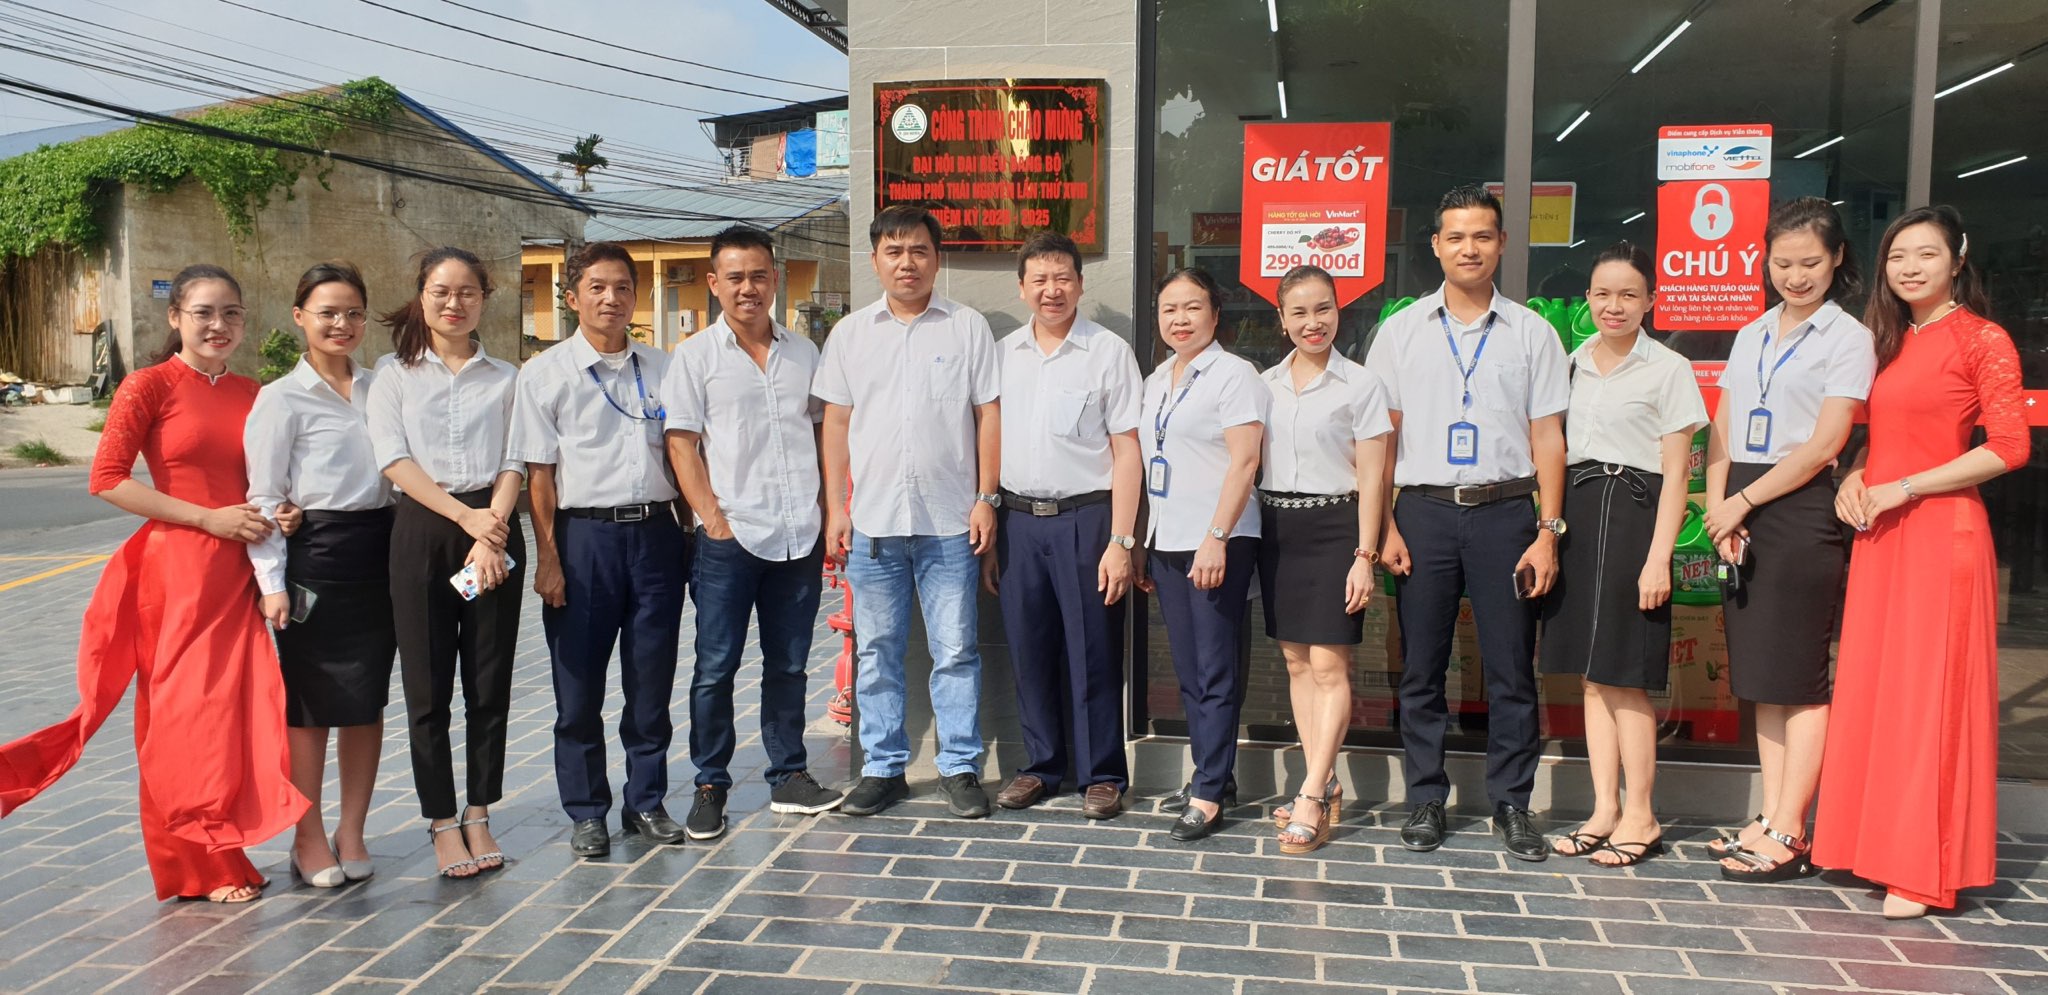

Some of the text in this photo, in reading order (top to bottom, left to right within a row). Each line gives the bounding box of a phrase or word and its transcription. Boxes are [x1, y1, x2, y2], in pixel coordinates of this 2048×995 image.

[931, 102, 1083, 141] CÔNG TRÌNH CHÀO MỪNG
[913, 155, 932, 177] ĐẠI
[935, 152, 954, 177] HỘI
[957, 155, 977, 177] ĐẠI
[980, 149, 1006, 173] BIỂU
[1045, 152, 1062, 176] BỘ
[1252, 145, 1384, 182] GIÁ TỐT
[1666, 162, 1716, 170] mobifone
[889, 180, 922, 200] THÀNH
[923, 177, 945, 200] PHỐ
[947, 179, 970, 199] THÁI
[1017, 176, 1038, 199] LẦN
[1040, 178, 1062, 199] THỨ
[963, 205, 979, 226] KỲ
[1021, 209, 1050, 226] 2025
[1265, 253, 1360, 270] 299000đ
[1663, 243, 1760, 277] CHÚ Ý
[1660, 283, 1760, 293] KHÁCH HÀNG TỰ BẢO QUẢN
[1666, 292, 1752, 302] XE VÀ TÀI SẢN CÁ NHÂN
[1672, 304, 1688, 313] lòng
[1683, 314, 1701, 323] hàng
[1681, 559, 1711, 581] NET
[1671, 637, 1698, 664] ET
